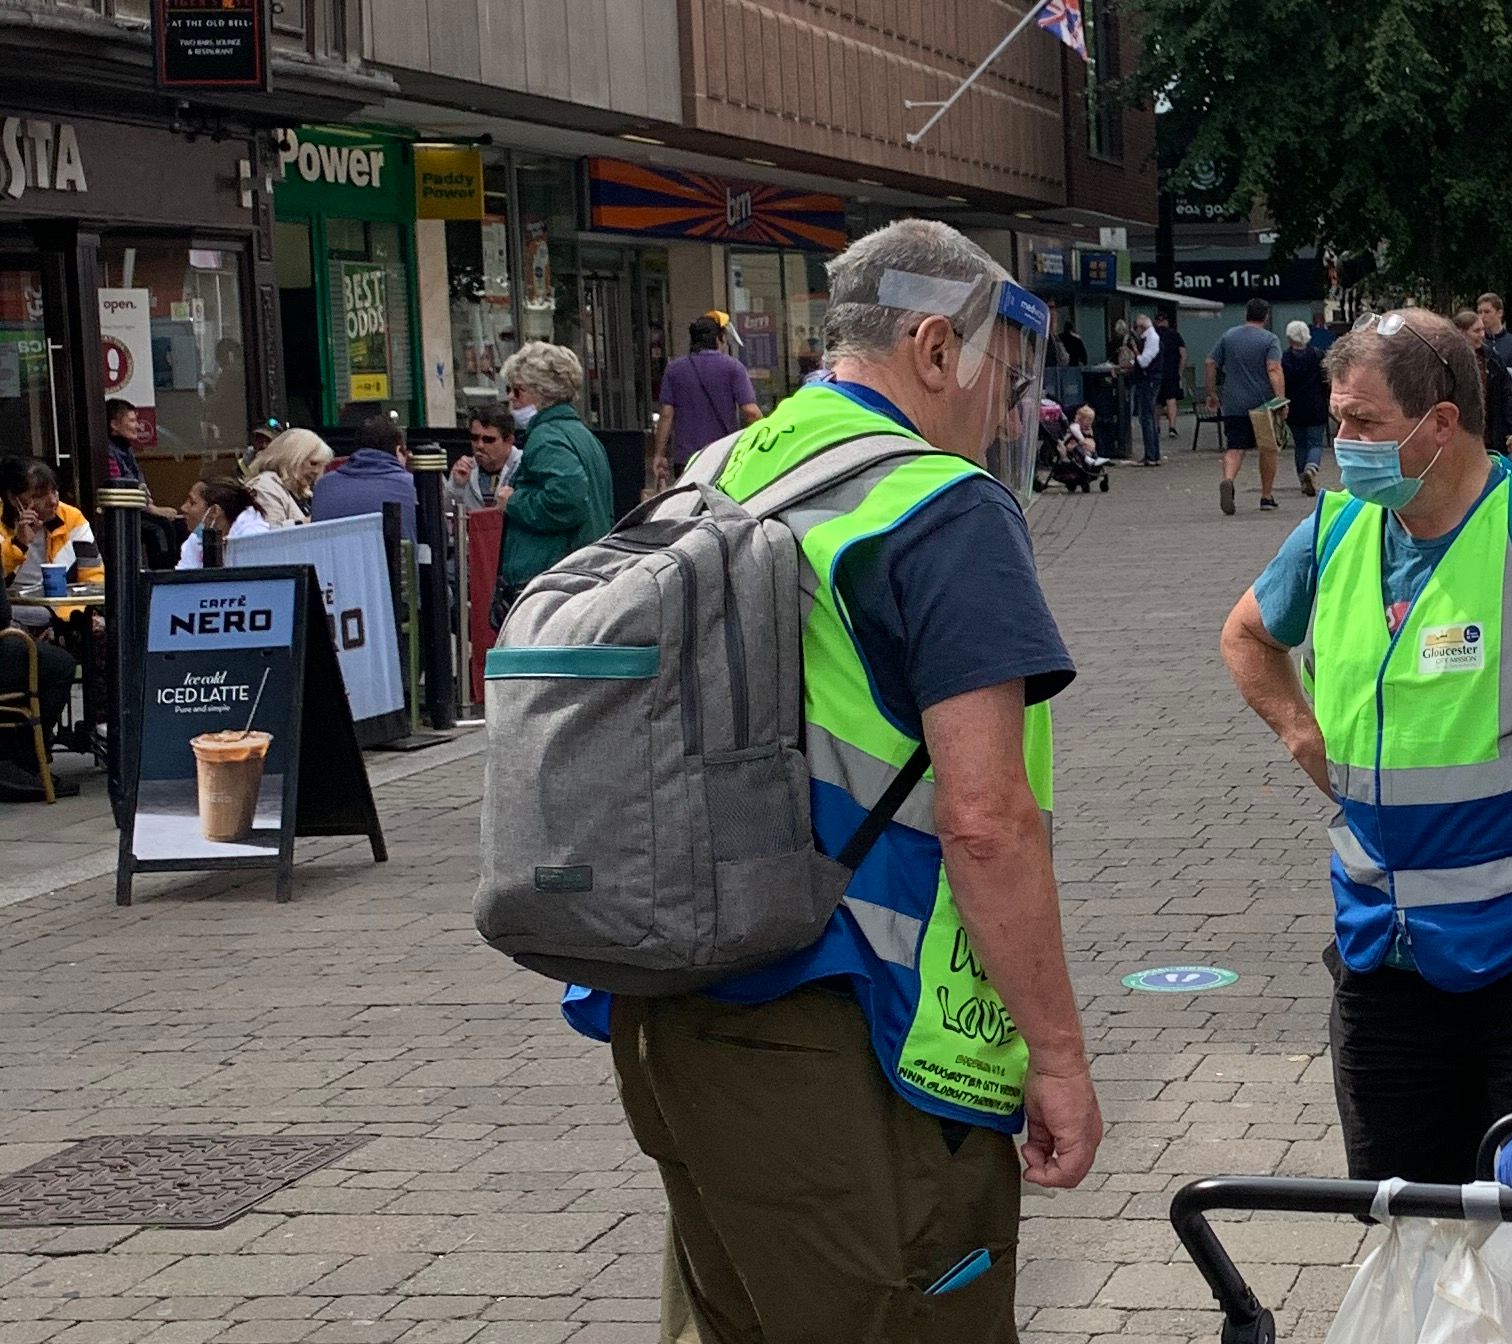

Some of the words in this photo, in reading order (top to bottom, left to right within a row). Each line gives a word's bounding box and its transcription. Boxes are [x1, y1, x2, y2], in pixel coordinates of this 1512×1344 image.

[171, 19, 182, 28] AT
[186, 19, 203, 28] THE
[206, 19, 225, 28] OLD
[228, 18, 249, 28] BELL
[275, 128, 385, 188] Power
[422, 171, 475, 187] Paddy
[422, 186, 475, 200] Power
[1135, 272, 1158, 288] da
[341, 270, 385, 312] BEST
[104, 299, 137, 314] open.
[347, 306, 385, 339] ODDS
[199, 594, 247, 609] CAFFÈ
[170, 609, 272, 637] NERO
[1422, 645, 1478, 659] Gloucester
[201, 670, 228, 686] cold
[157, 687, 198, 705] ICED
[199, 685, 250, 703] LATTE
[174, 705, 192, 714] Pure
[206, 704, 231, 715] simple
[937, 985, 1017, 1047] LOVE
